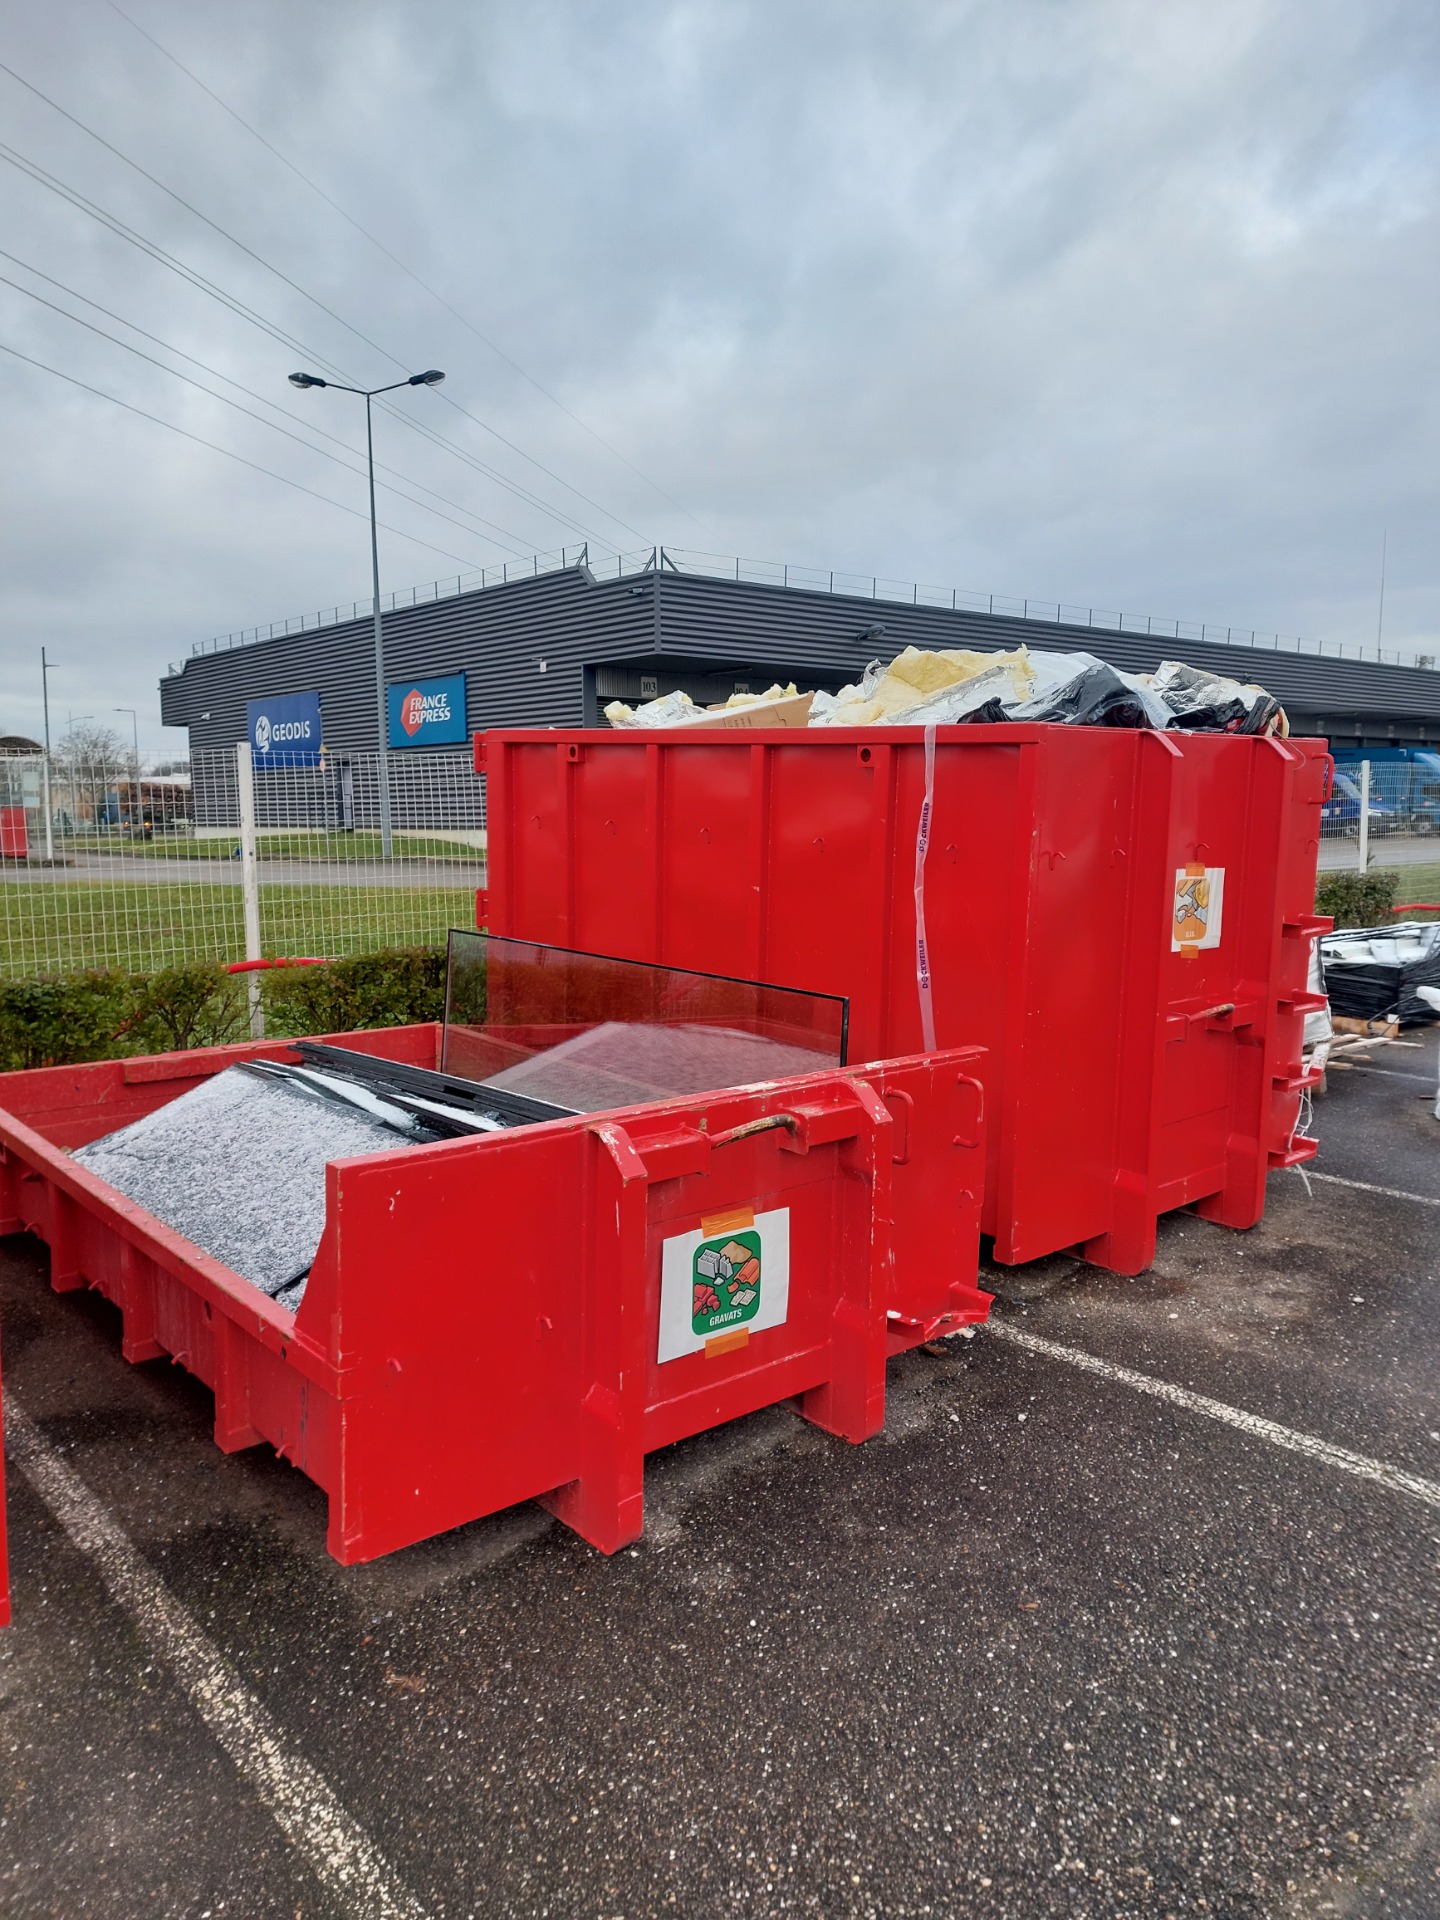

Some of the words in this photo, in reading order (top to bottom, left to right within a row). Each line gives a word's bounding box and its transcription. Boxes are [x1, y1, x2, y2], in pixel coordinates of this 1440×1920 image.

[642, 681, 656, 693] 103
[410, 693, 448, 711] FRANCE
[409, 707, 451, 725] EXPRESS
[272, 721, 311, 742] GEODIS
[918, 802, 930, 852] DOCKWEILER
[918, 939, 929, 989] DOCKWEILER
[709, 1308, 743, 1327] GRAVATS
